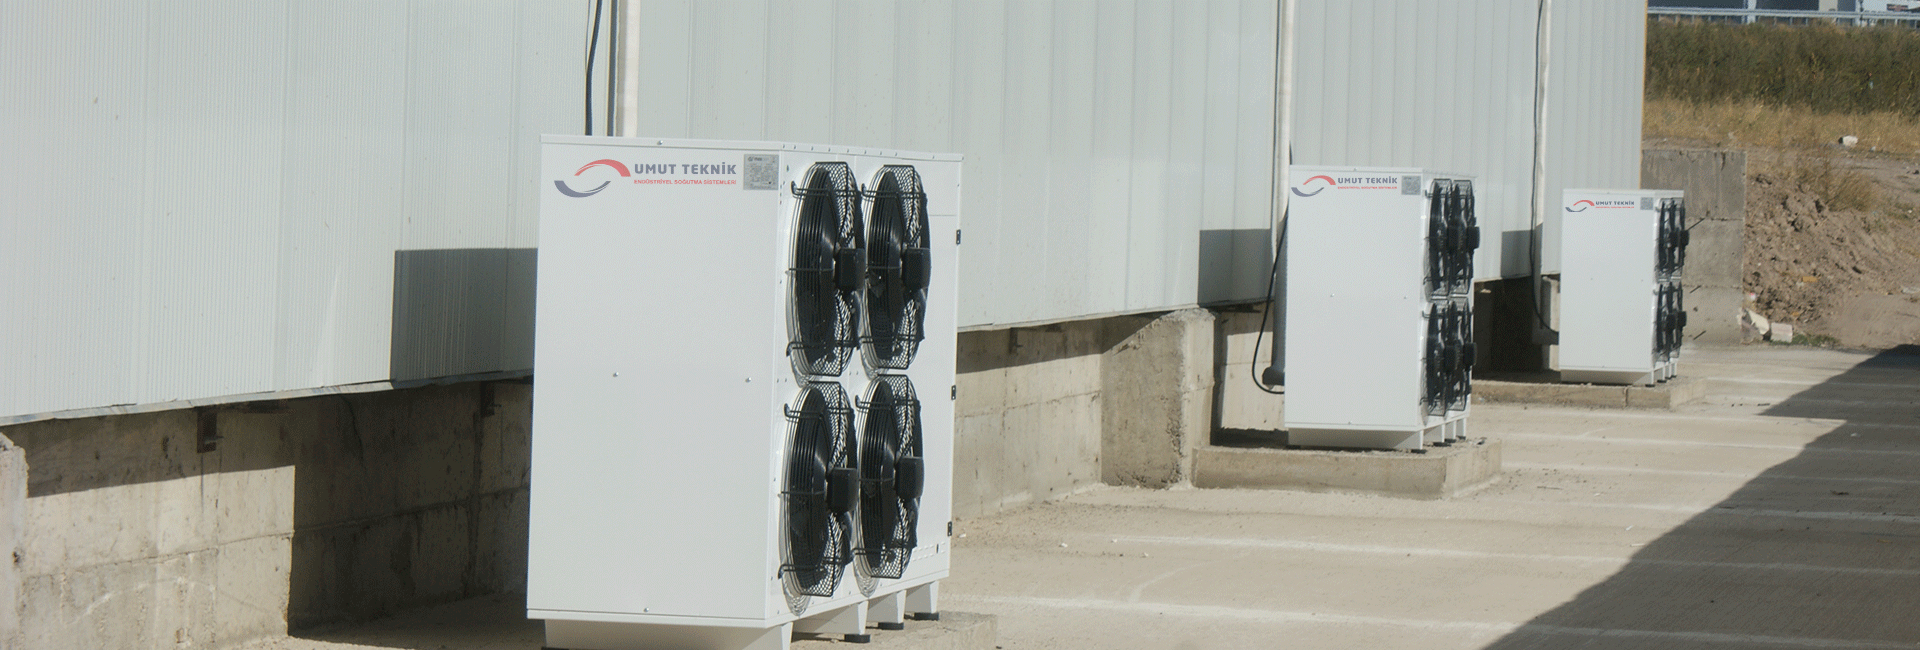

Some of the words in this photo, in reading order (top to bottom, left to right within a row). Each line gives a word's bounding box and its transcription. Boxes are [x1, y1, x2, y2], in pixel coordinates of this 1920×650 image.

[634, 163, 677, 175] UMUT
[682, 161, 737, 175] TEKNİK
[1365, 176, 1398, 184] TEKNİK
